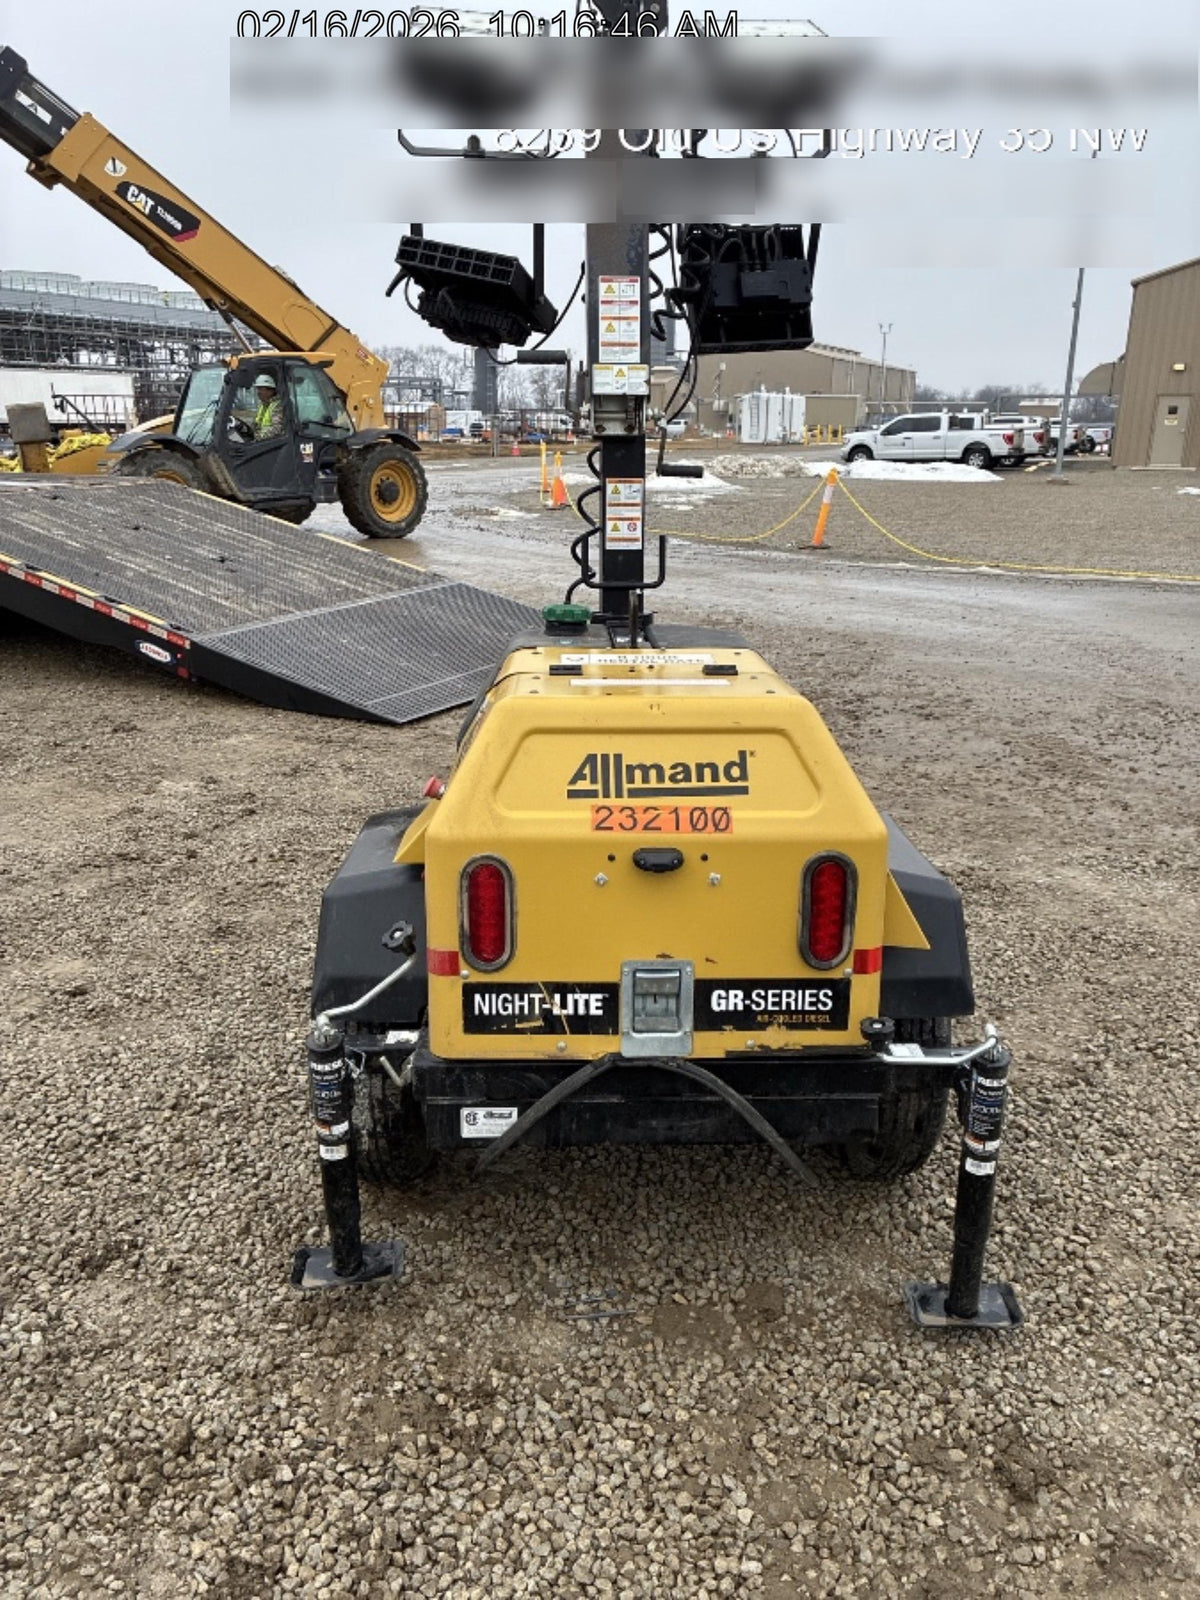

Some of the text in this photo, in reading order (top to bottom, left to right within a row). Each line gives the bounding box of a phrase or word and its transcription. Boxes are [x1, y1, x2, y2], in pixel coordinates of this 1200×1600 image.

[126, 184, 155, 215] CAT
[566, 750, 750, 799] Allmand
[594, 805, 731, 831] 232100
[474, 992, 604, 1016] NIGHT-LITE
[711, 989, 833, 1012] GR-SERIES
